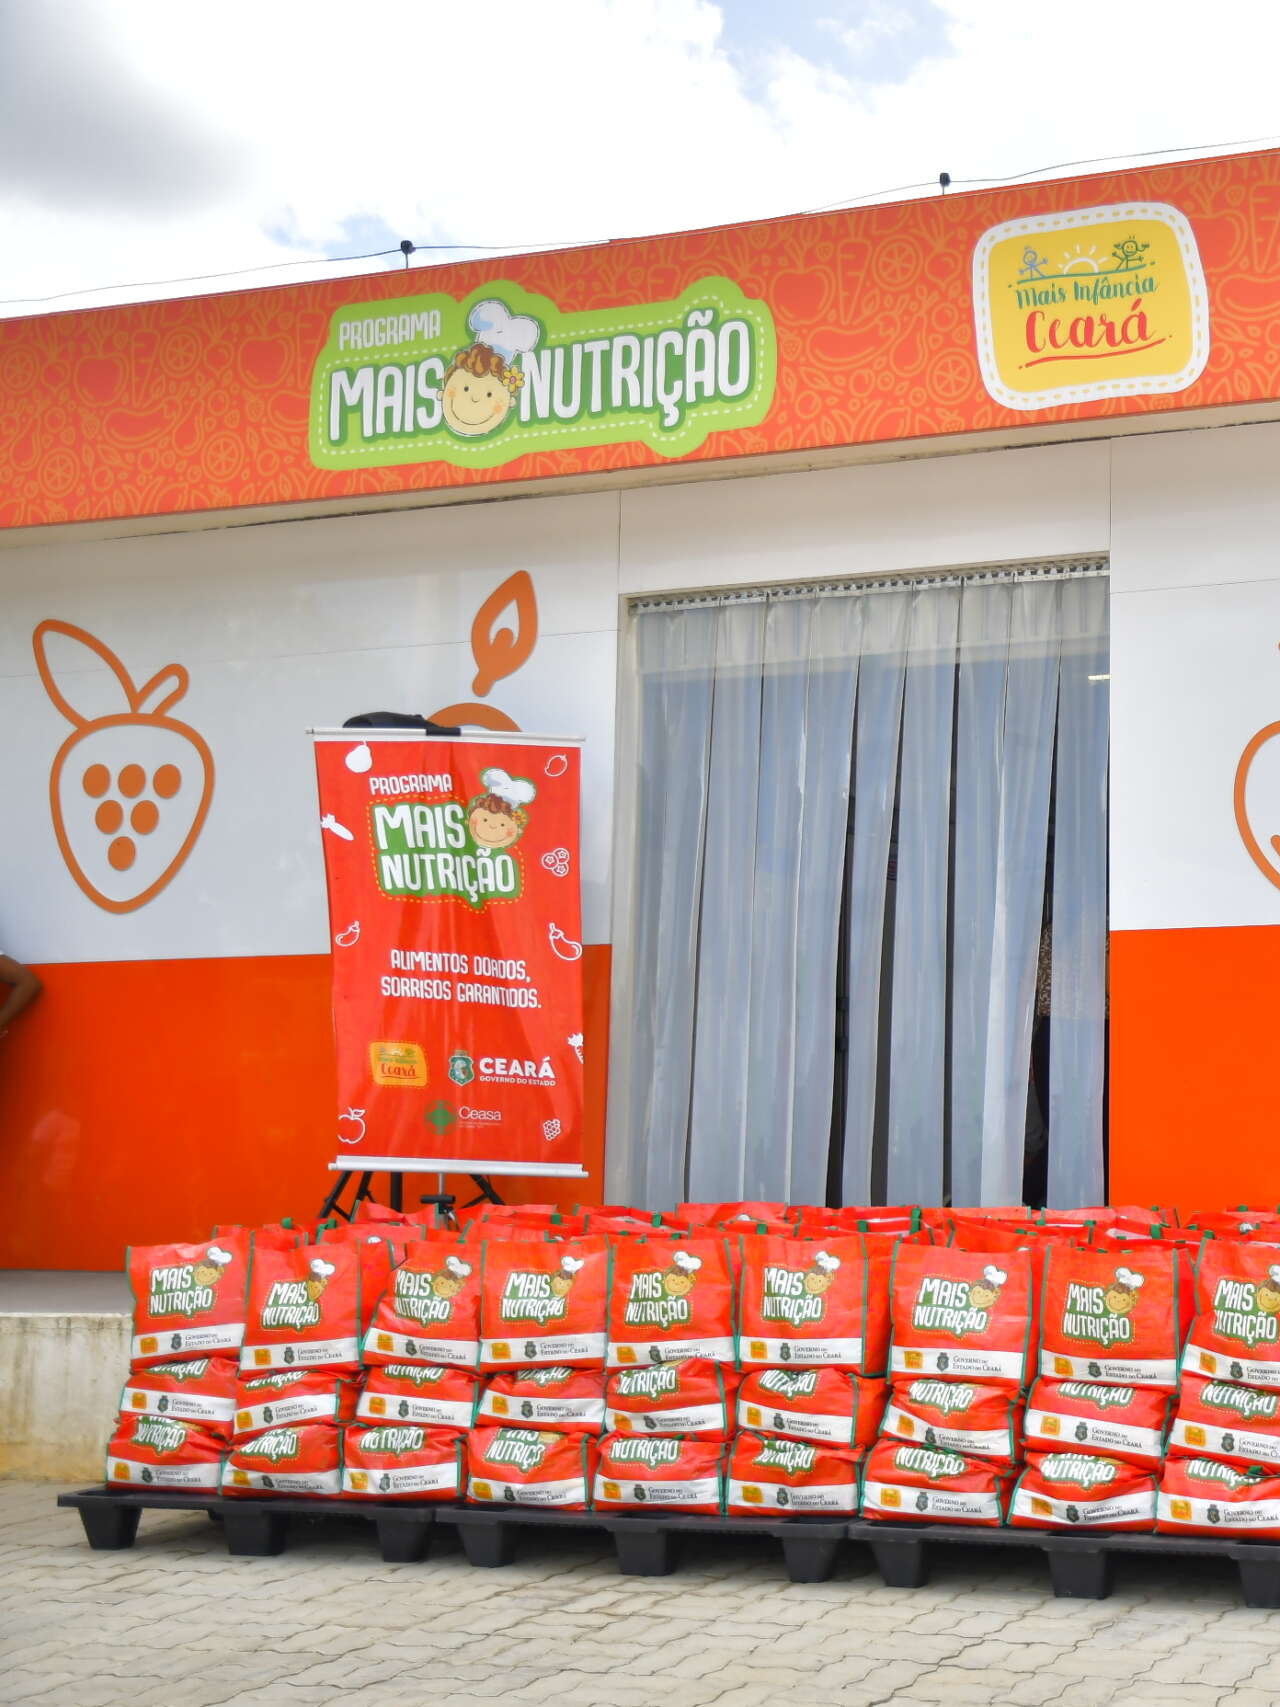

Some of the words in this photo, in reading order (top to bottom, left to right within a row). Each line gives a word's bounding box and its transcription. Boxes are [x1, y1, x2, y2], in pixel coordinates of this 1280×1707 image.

[1016, 285, 1067, 309] Mais
[1073, 274, 1158, 304] Infância
[339, 309, 441, 350] PROGRAMA
[1026, 298, 1156, 353] Ceará
[330, 358, 446, 441] MAIS
[520, 310, 751, 427] NUTRIÇÃO
[369, 774, 453, 795] PROGRAMA
[374, 804, 466, 849] MAIS
[381, 847, 515, 902] NUTRIÇÃO
[390, 949, 468, 974] ALIMENTOS
[474, 955, 531, 982] DOADOS,
[381, 976, 451, 1000] SORRISOS
[457, 982, 542, 1009] GARANTIDOS.
[479, 1056, 556, 1079] CEARÁ
[480, 1075, 516, 1084] GOVERNO
[517, 1077, 528, 1085] DO
[459, 1105, 502, 1121] Ceasa
[152, 1266, 194, 1292] MAIS
[267, 1282, 307, 1305] MAIS
[396, 1270, 431, 1296] MAIS
[506, 1273, 550, 1298] MAIS
[631, 1274, 662, 1298] MAIS
[765, 1268, 803, 1296] MAIS
[918, 1278, 968, 1307] MAIS
[151, 1286, 212, 1315] NUTRIÇÃO
[1067, 1284, 1103, 1313] MAIS
[1214, 1280, 1255, 1309] MAIS
[263, 1302, 319, 1329] NUTRIÇÃO
[503, 1296, 564, 1324] NUTRIÇÃO
[626, 1298, 688, 1326] NUTRIÇÃO
[764, 1295, 821, 1325] NUTRIÇÃO
[914, 1304, 987, 1334] NUTRIÇÃO
[1064, 1313, 1129, 1344] NUTRIÇÃO
[909, 1381, 974, 1413] NUTRIÇÃO
[1042, 1458, 1116, 1488] NUTRIÇÃO
